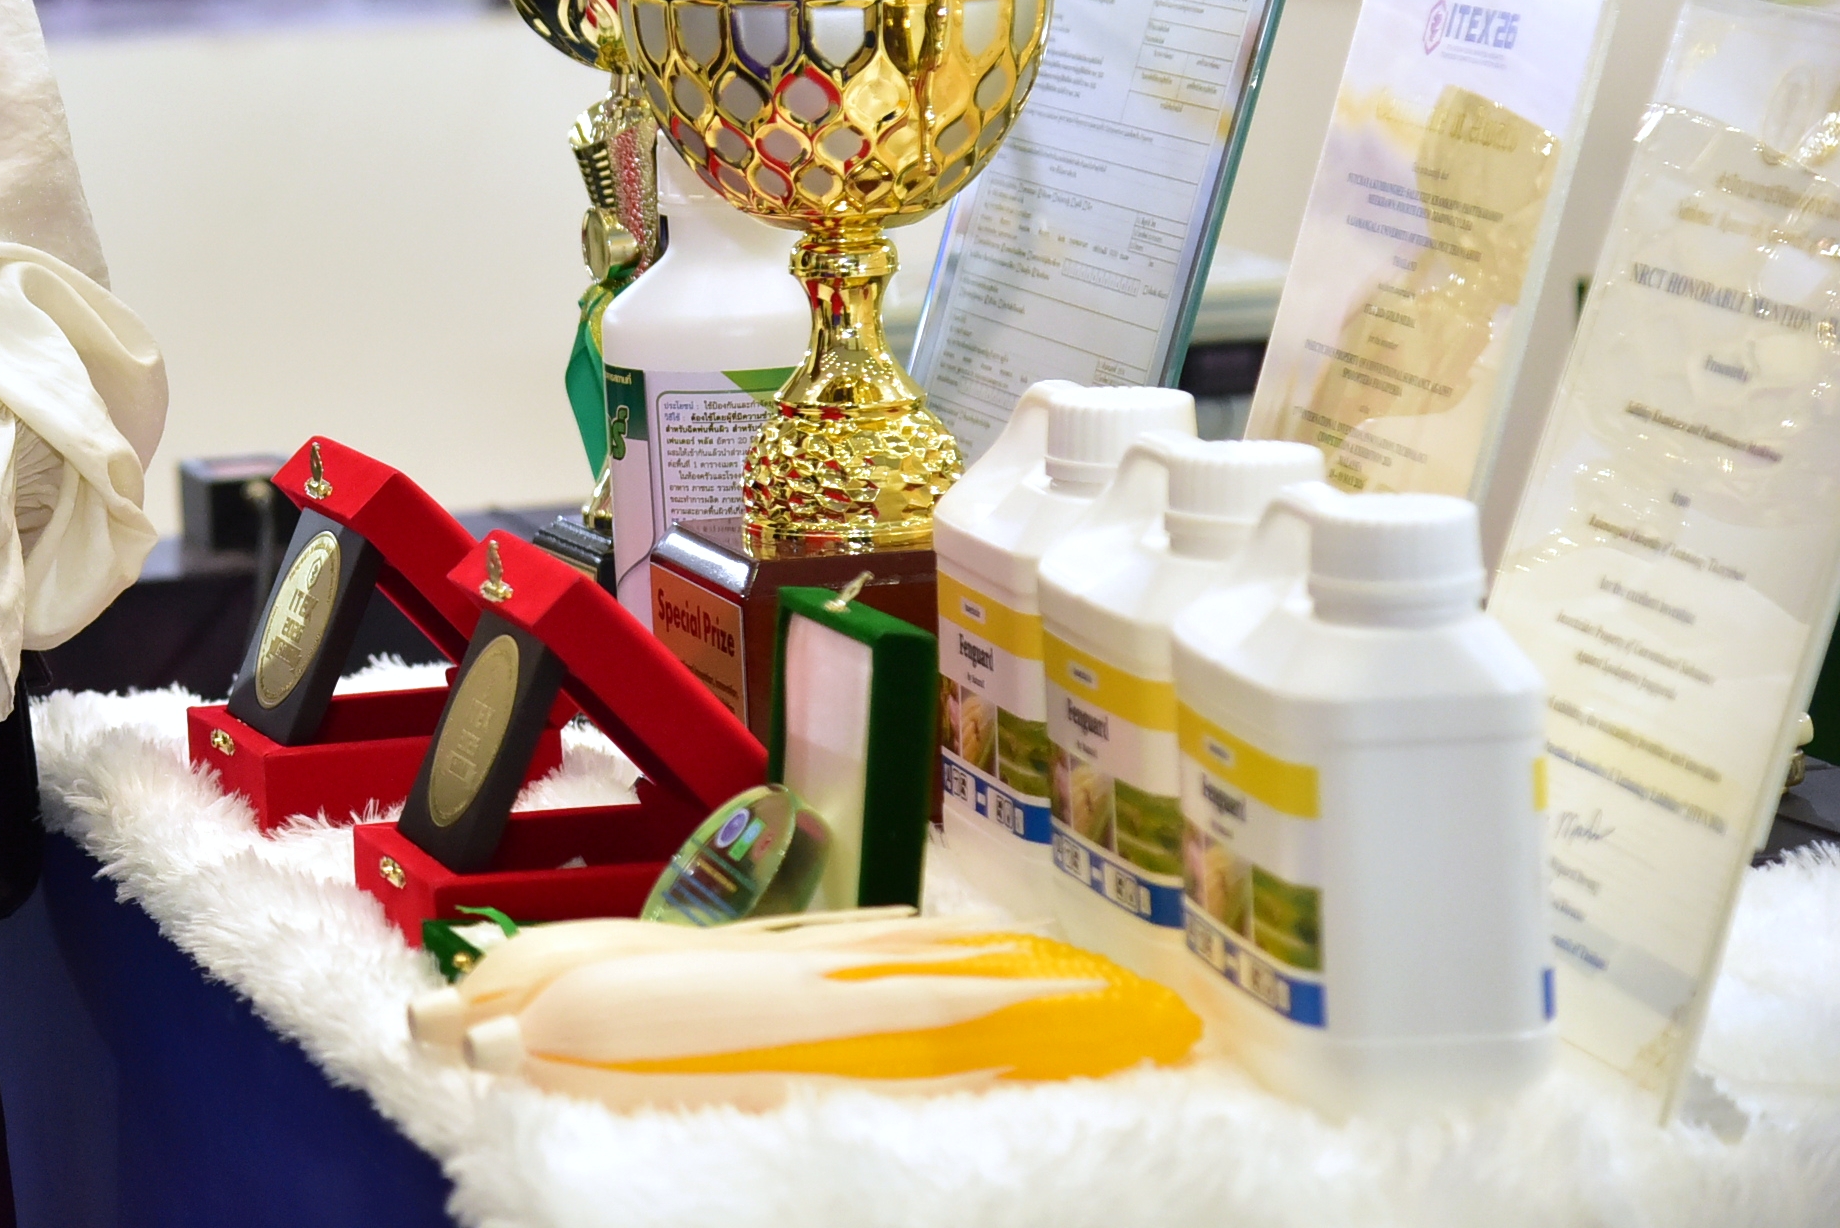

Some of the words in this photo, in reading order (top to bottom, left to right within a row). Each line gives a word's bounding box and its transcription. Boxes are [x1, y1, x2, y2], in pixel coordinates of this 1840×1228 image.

[738, 436, 748, 444] 20
[658, 588, 702, 640] Special
[703, 611, 735, 658] Prize
[958, 632, 994, 672] Fenguard
